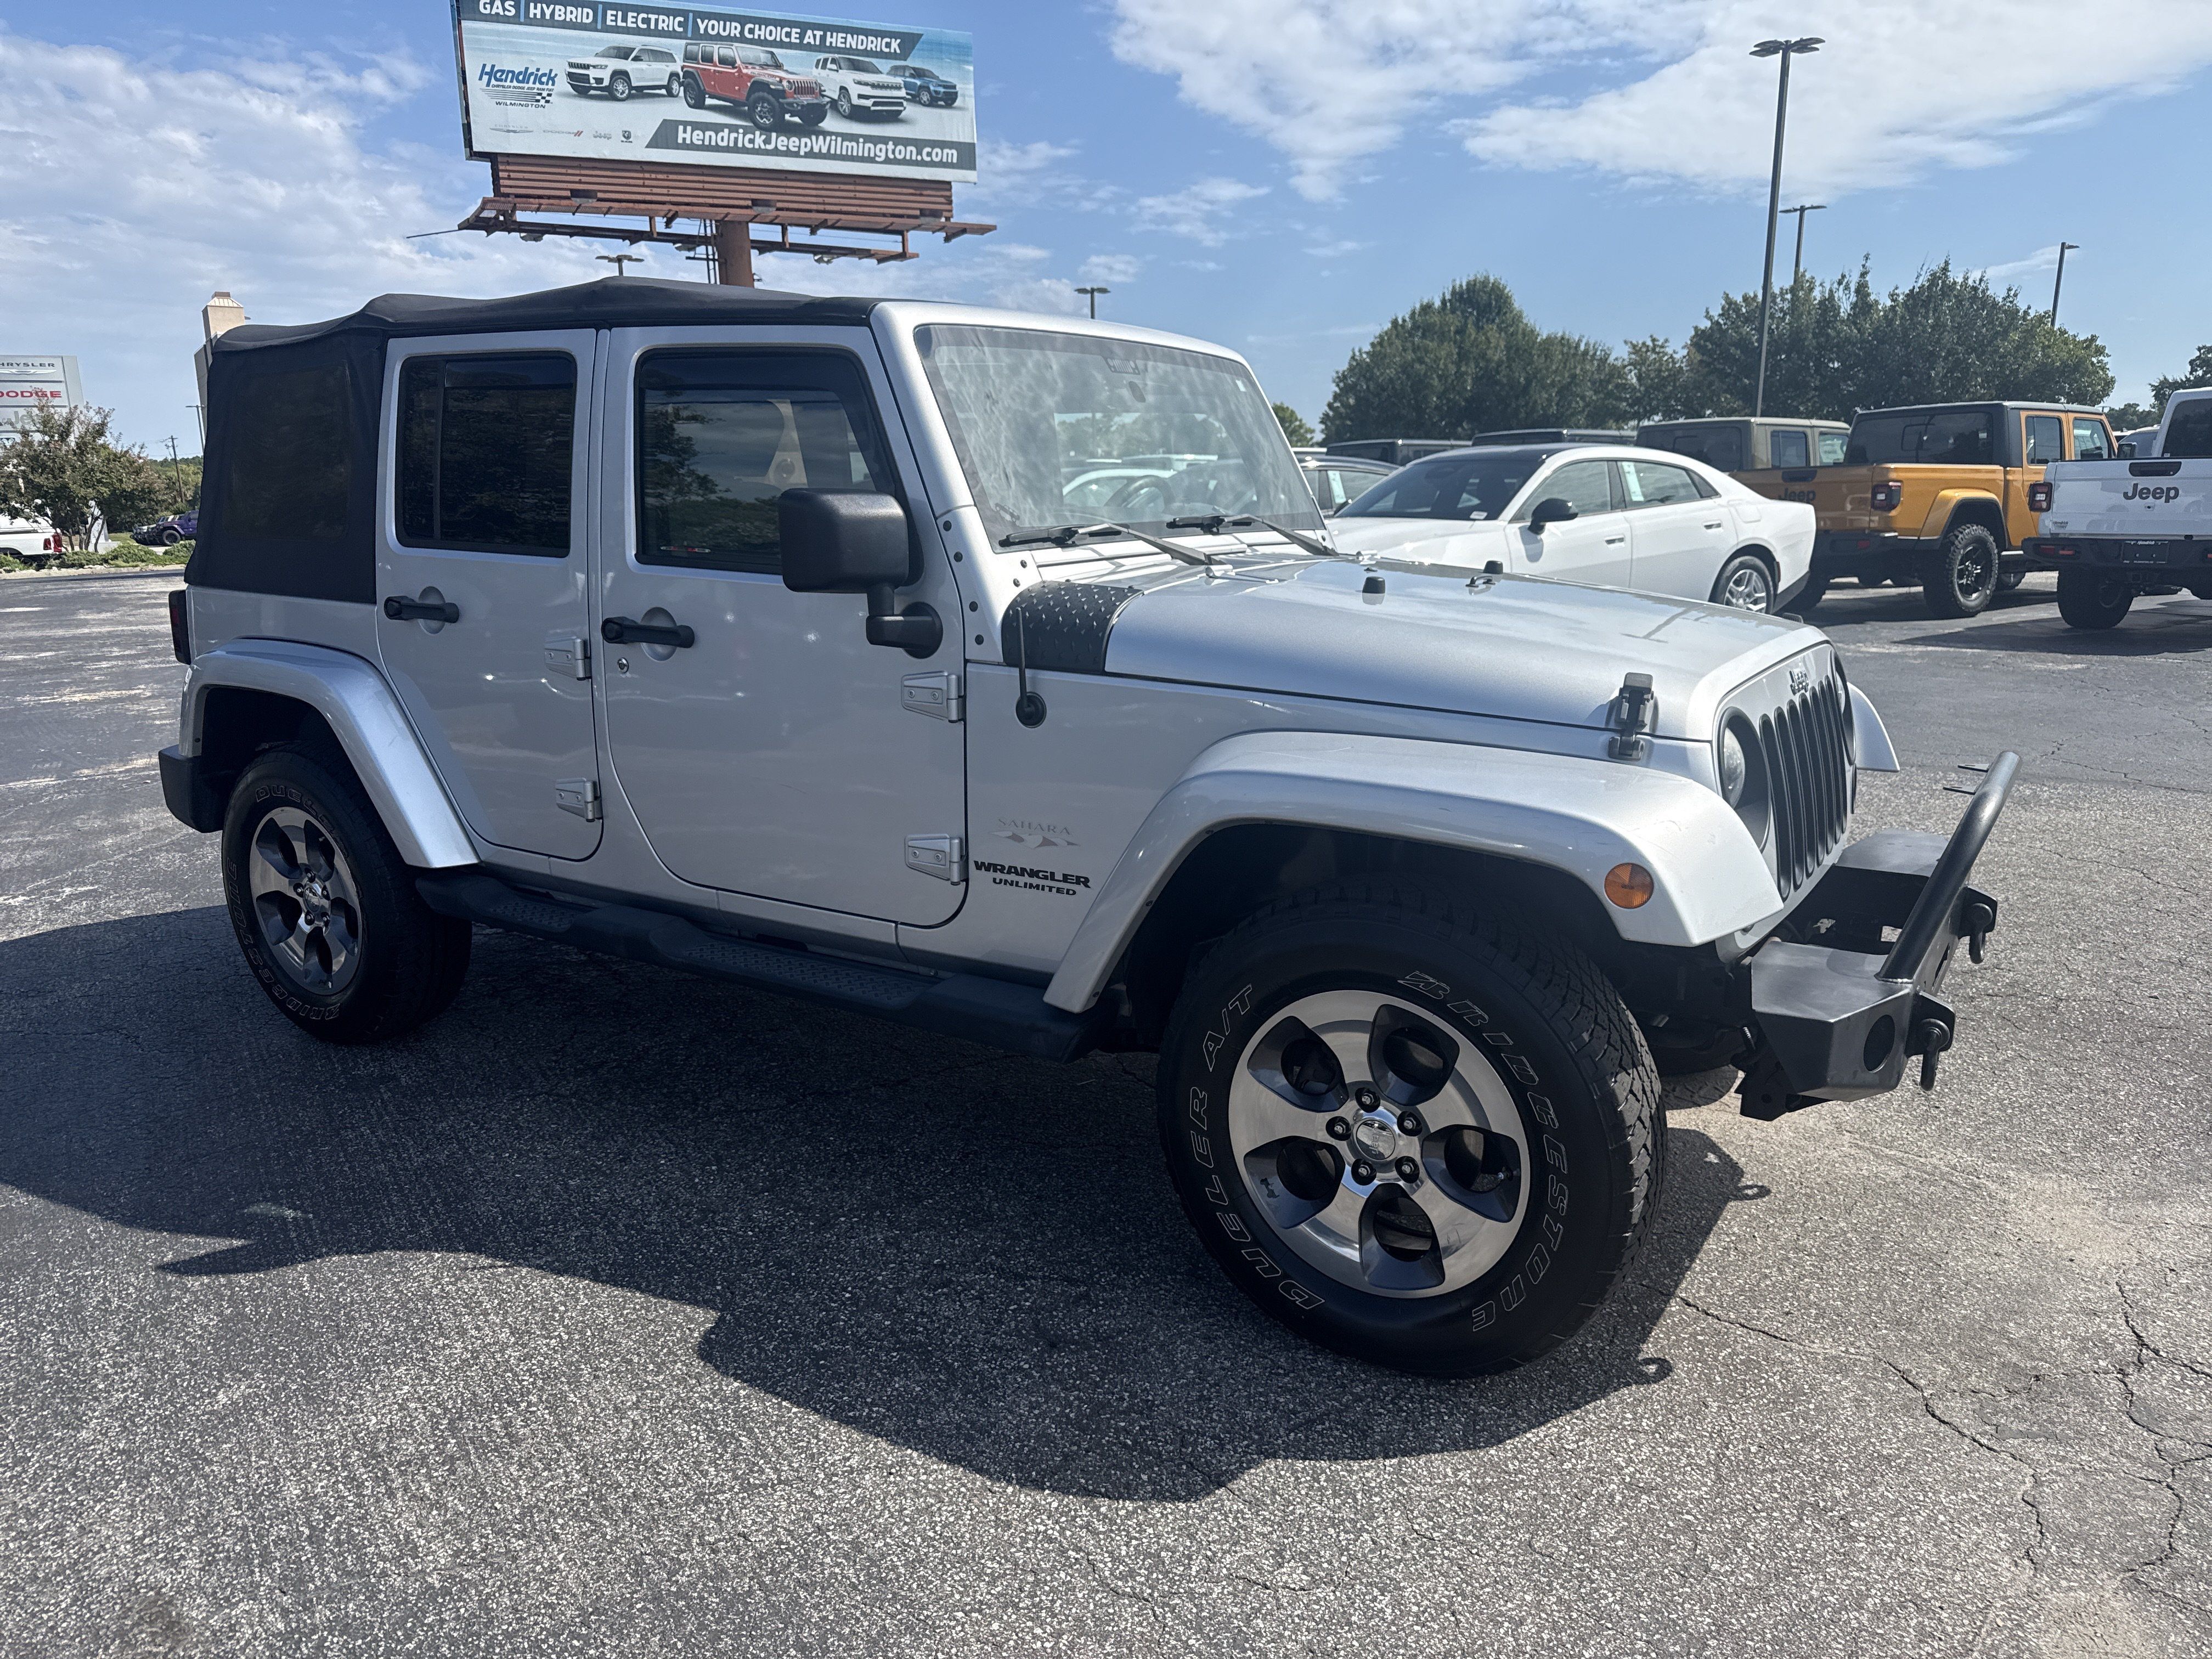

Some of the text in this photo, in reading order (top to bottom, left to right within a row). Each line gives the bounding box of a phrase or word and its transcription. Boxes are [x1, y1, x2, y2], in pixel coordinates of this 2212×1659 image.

[479, 0, 901, 53] GAS HYBRID ELECTRIC YOUR CHOICE AT HENDRICK
[478, 64, 558, 87] Hendrick
[677, 125, 958, 163] HendrickJeepWilmington.com
[2123, 483, 2180, 503] Jeep
[998, 817, 1071, 835] SAHARA
[974, 860, 1091, 889] WRANGLER
[992, 877, 1077, 896] UNLIMITED
[227, 857, 340, 1020] BRIDGESTONE
[1190, 984, 1325, 1310] DUELER A/T
[1397, 970, 1570, 1331] BRIDGESTONE
